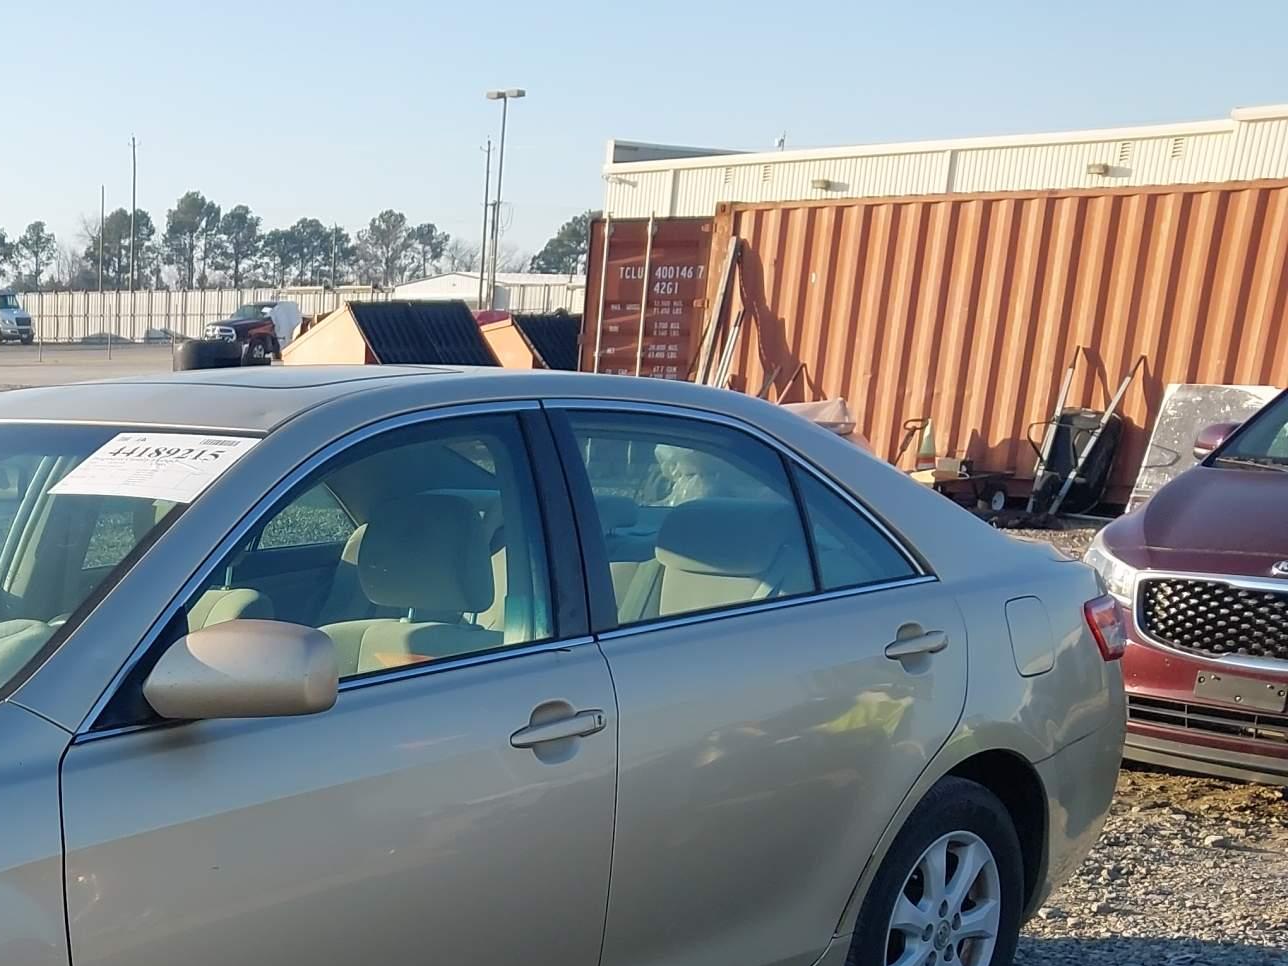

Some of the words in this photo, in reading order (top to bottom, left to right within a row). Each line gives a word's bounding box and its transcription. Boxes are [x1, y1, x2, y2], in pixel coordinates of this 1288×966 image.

[619, 266, 644, 279] TCLU
[655, 265, 694, 279] 400146
[697, 265, 705, 279] 7
[653, 281, 679, 295] 42G1
[109, 446, 227, 462] 44189215
